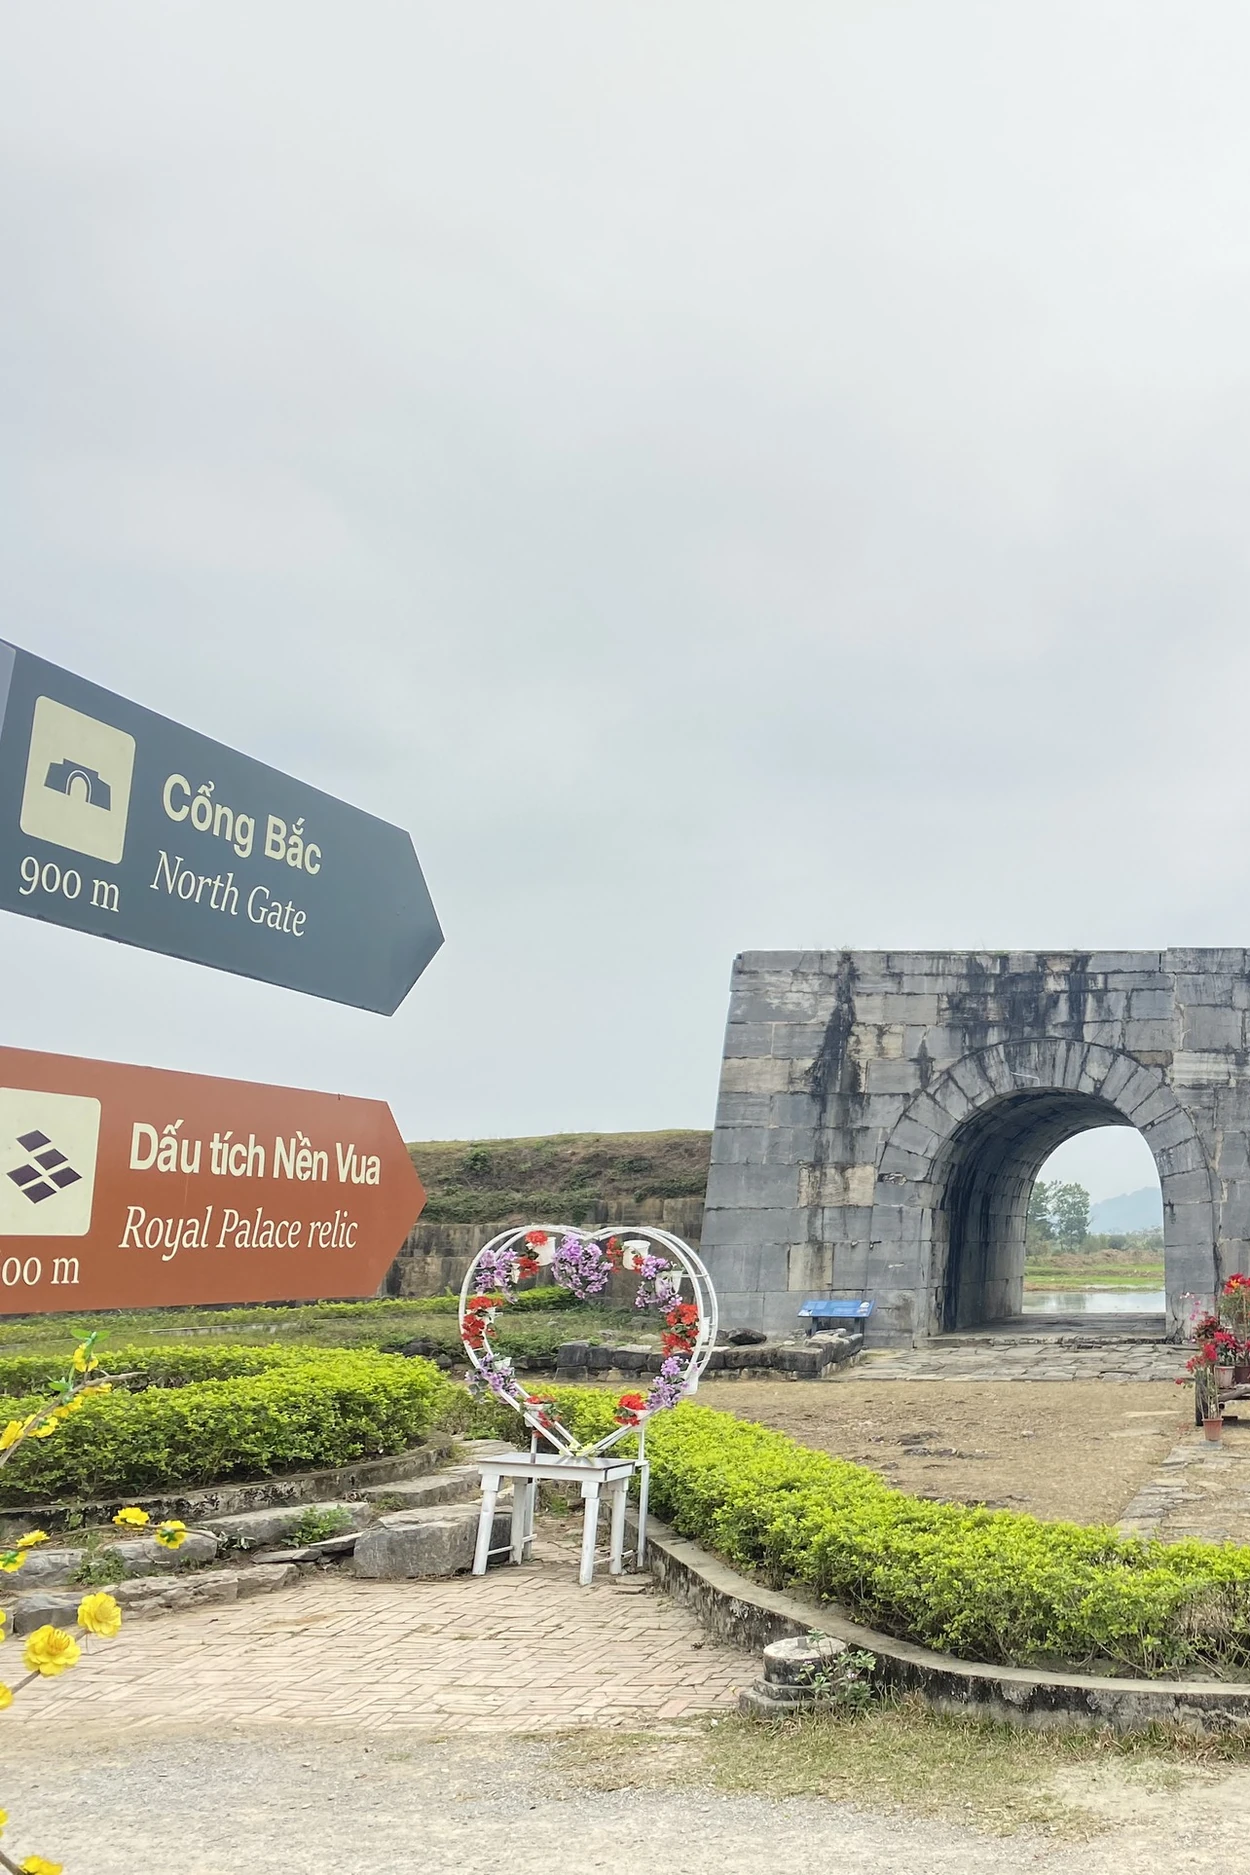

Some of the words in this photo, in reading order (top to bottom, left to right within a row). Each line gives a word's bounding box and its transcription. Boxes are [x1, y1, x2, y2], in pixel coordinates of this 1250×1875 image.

[162, 773, 255, 859] Cổng
[264, 816, 322, 875] Bắc
[18, 856, 82, 900] 900
[89, 878, 120, 912] m
[149, 850, 240, 916] North
[247, 885, 307, 937] Gate
[129, 1119, 201, 1175] Dấu
[209, 1131, 267, 1177] tích
[272, 1130, 329, 1182] Nền
[335, 1142, 381, 1185] Vua
[118, 1205, 213, 1262] Royal
[215, 1208, 300, 1249] Palace
[307, 1210, 359, 1249] relic
[50, 1257, 80, 1285] m
